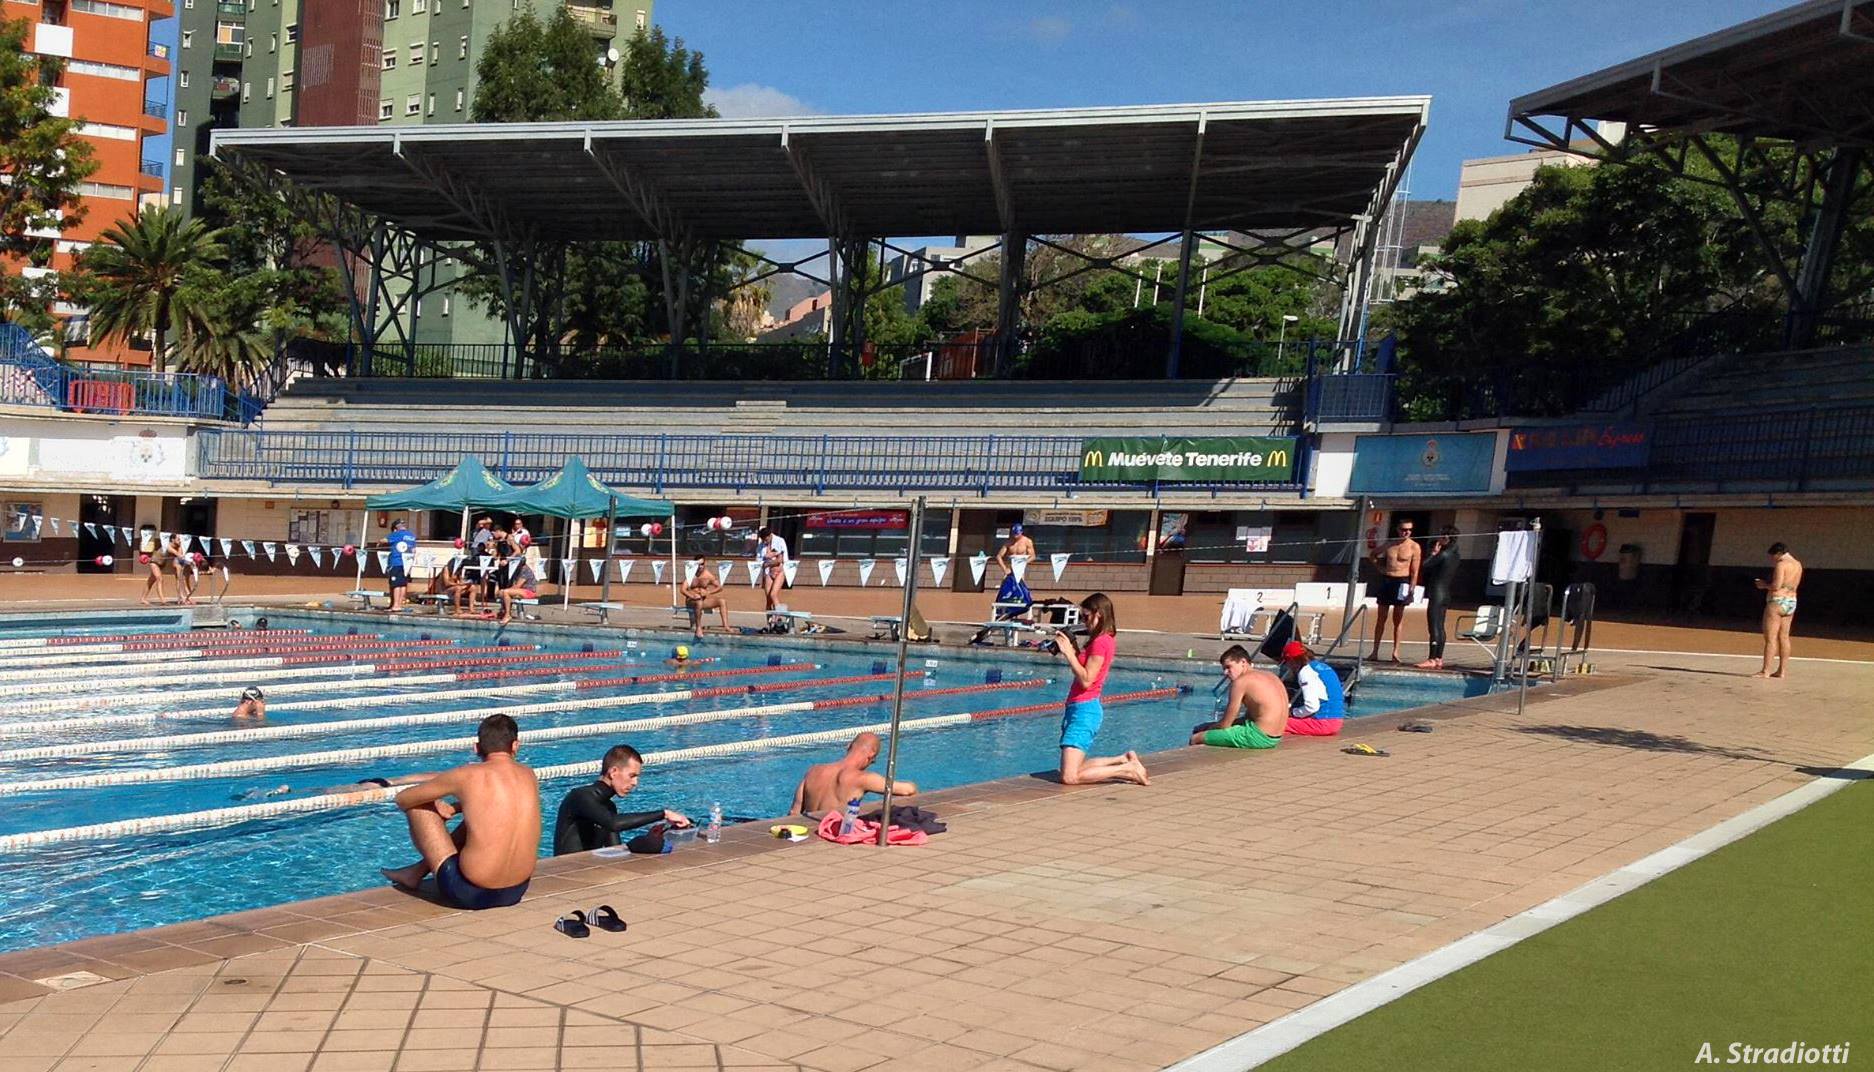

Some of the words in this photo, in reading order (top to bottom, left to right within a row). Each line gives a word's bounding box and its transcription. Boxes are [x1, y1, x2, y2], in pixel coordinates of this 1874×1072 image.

[1107, 451, 1183, 467] Muévete
[1184, 451, 1263, 467] Tenerife
[1256, 592, 1263, 603] 2
[1326, 587, 1332, 599] 1
